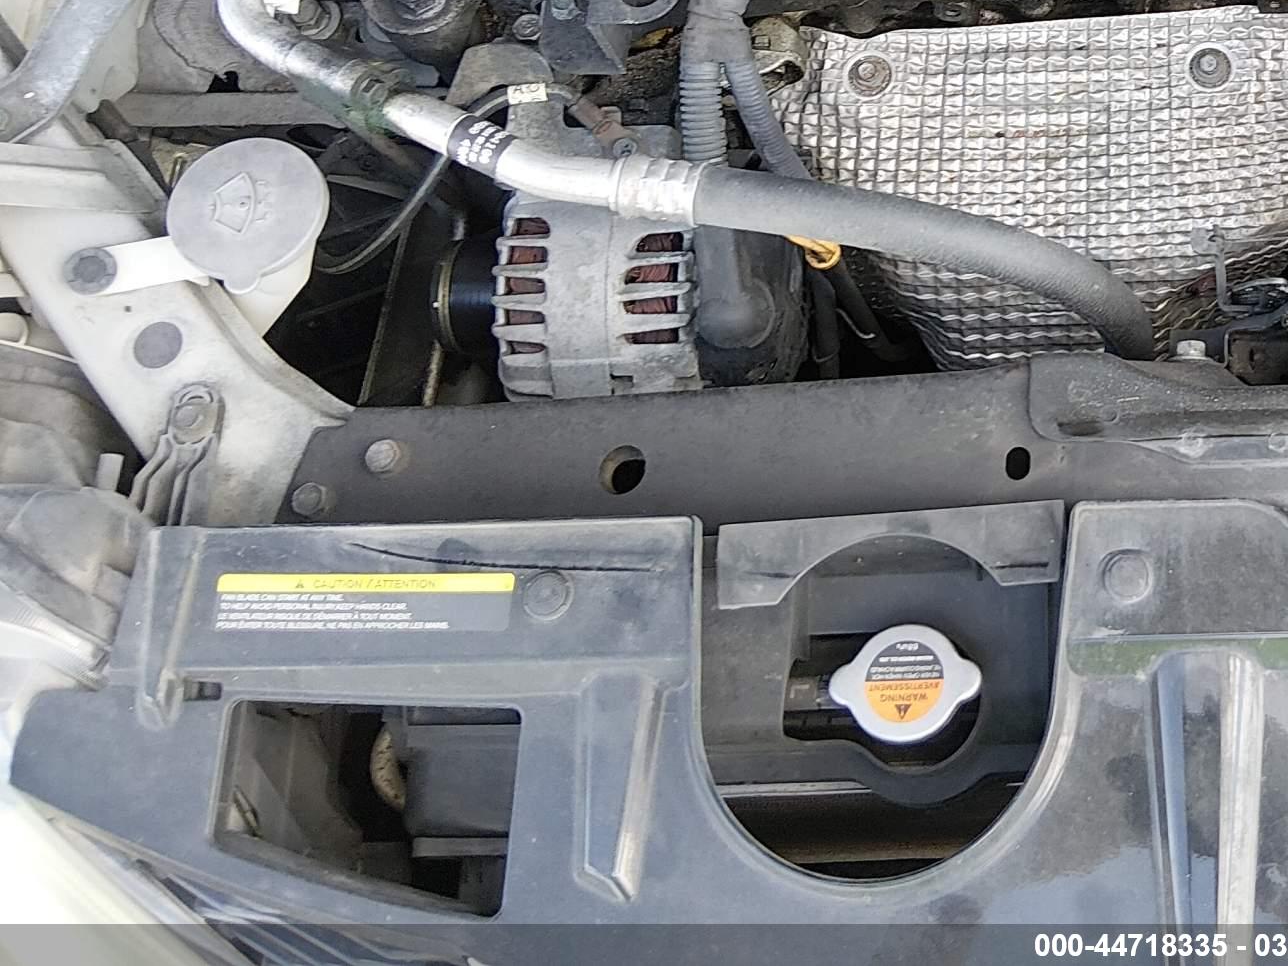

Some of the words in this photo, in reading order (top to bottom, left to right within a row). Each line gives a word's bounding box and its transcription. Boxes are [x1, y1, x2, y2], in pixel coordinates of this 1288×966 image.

[312, 579, 362, 589] CAUTION
[374, 579, 437, 589] ATTENTION
[868, 682, 940, 692] AVERTISSEMENT
[880, 693, 928, 702] WARNING
